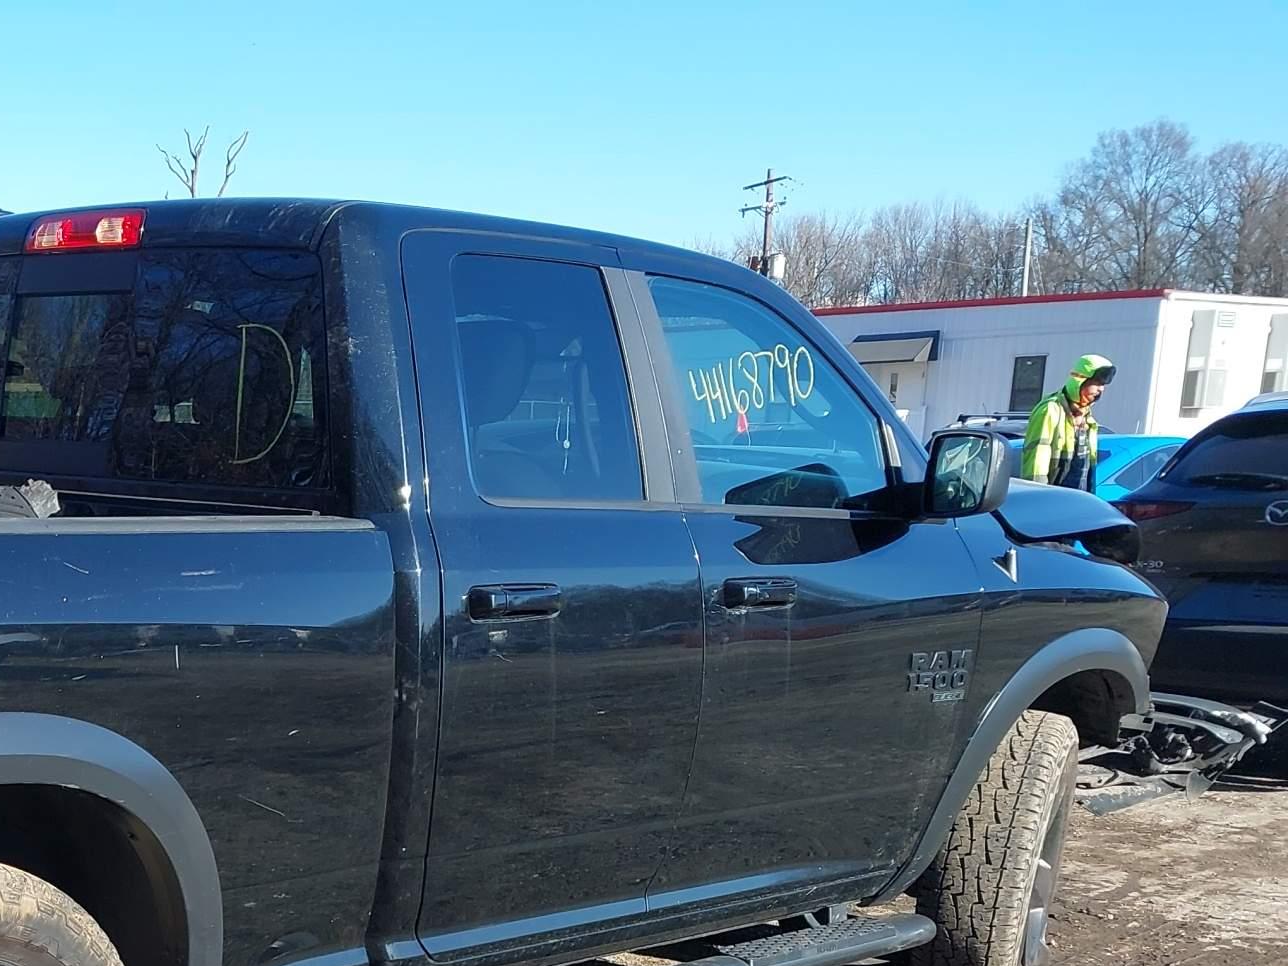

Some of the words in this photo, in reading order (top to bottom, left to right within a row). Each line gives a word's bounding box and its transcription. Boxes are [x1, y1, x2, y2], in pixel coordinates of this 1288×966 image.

[688, 344, 814, 423] 44168790
[911, 649, 974, 671] RAM
[907, 669, 969, 691] 1500
